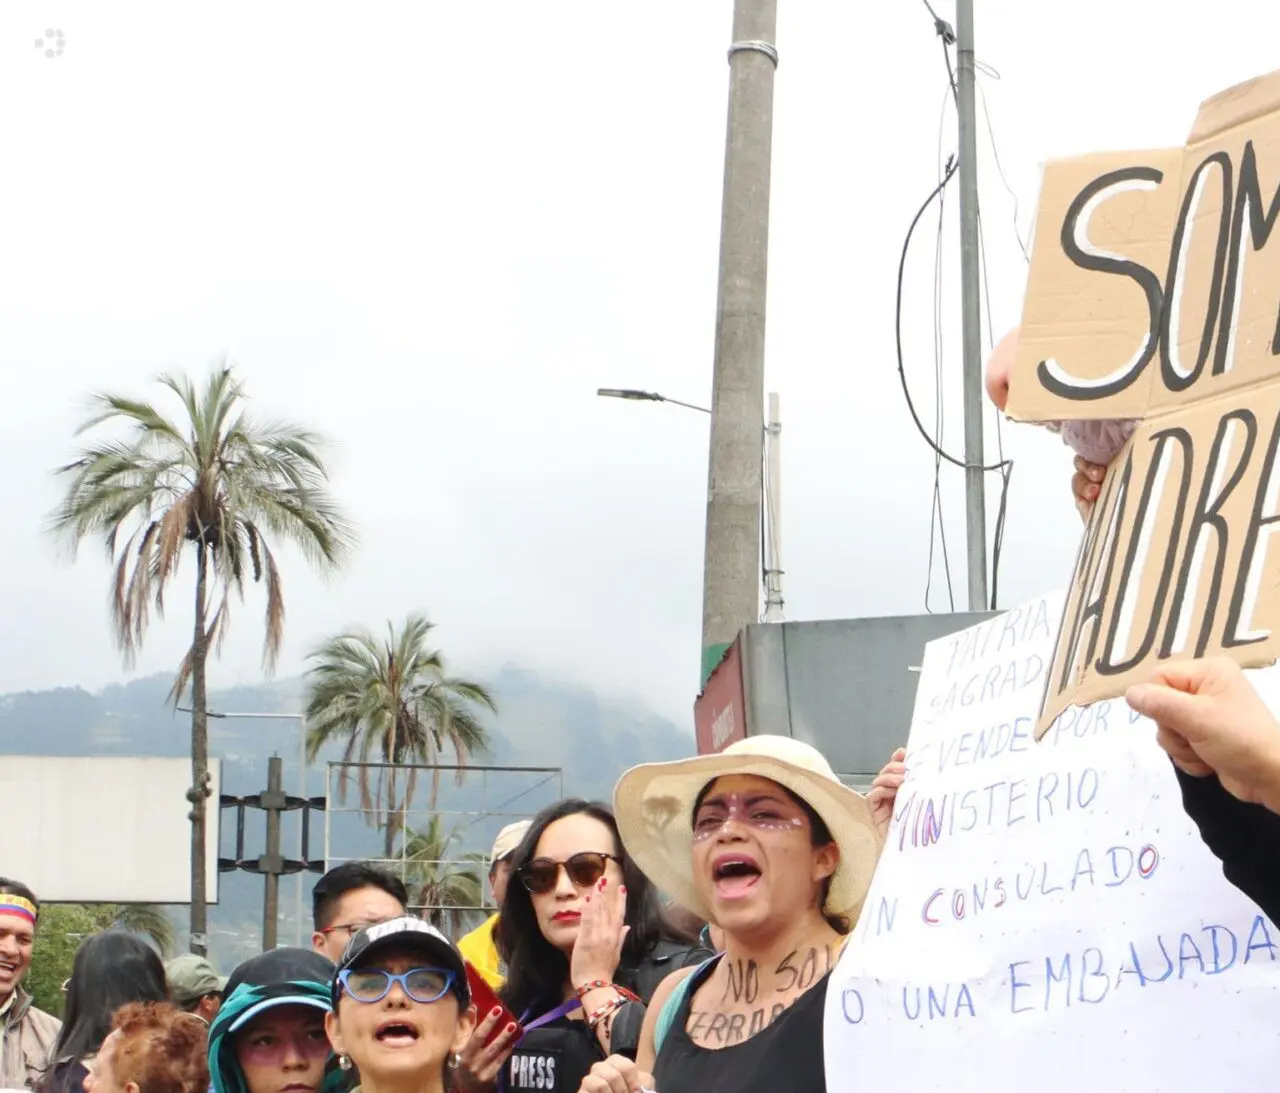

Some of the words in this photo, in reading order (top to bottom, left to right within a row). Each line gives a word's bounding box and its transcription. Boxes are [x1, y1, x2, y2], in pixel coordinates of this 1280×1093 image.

[923, 654, 1044, 725] SAGRAD
[936, 717, 1033, 774] VENDE
[1054, 701, 1113, 746] POR
[894, 768, 1099, 852] MINISTERIO
[921, 843, 1160, 927] CONSULADO
[722, 957, 760, 1005] NO
[841, 988, 866, 1025] O
[902, 983, 977, 1021] UNA
[1009, 914, 1279, 1015] EMBAJADA
[510, 1054, 556, 1090] PRESS
